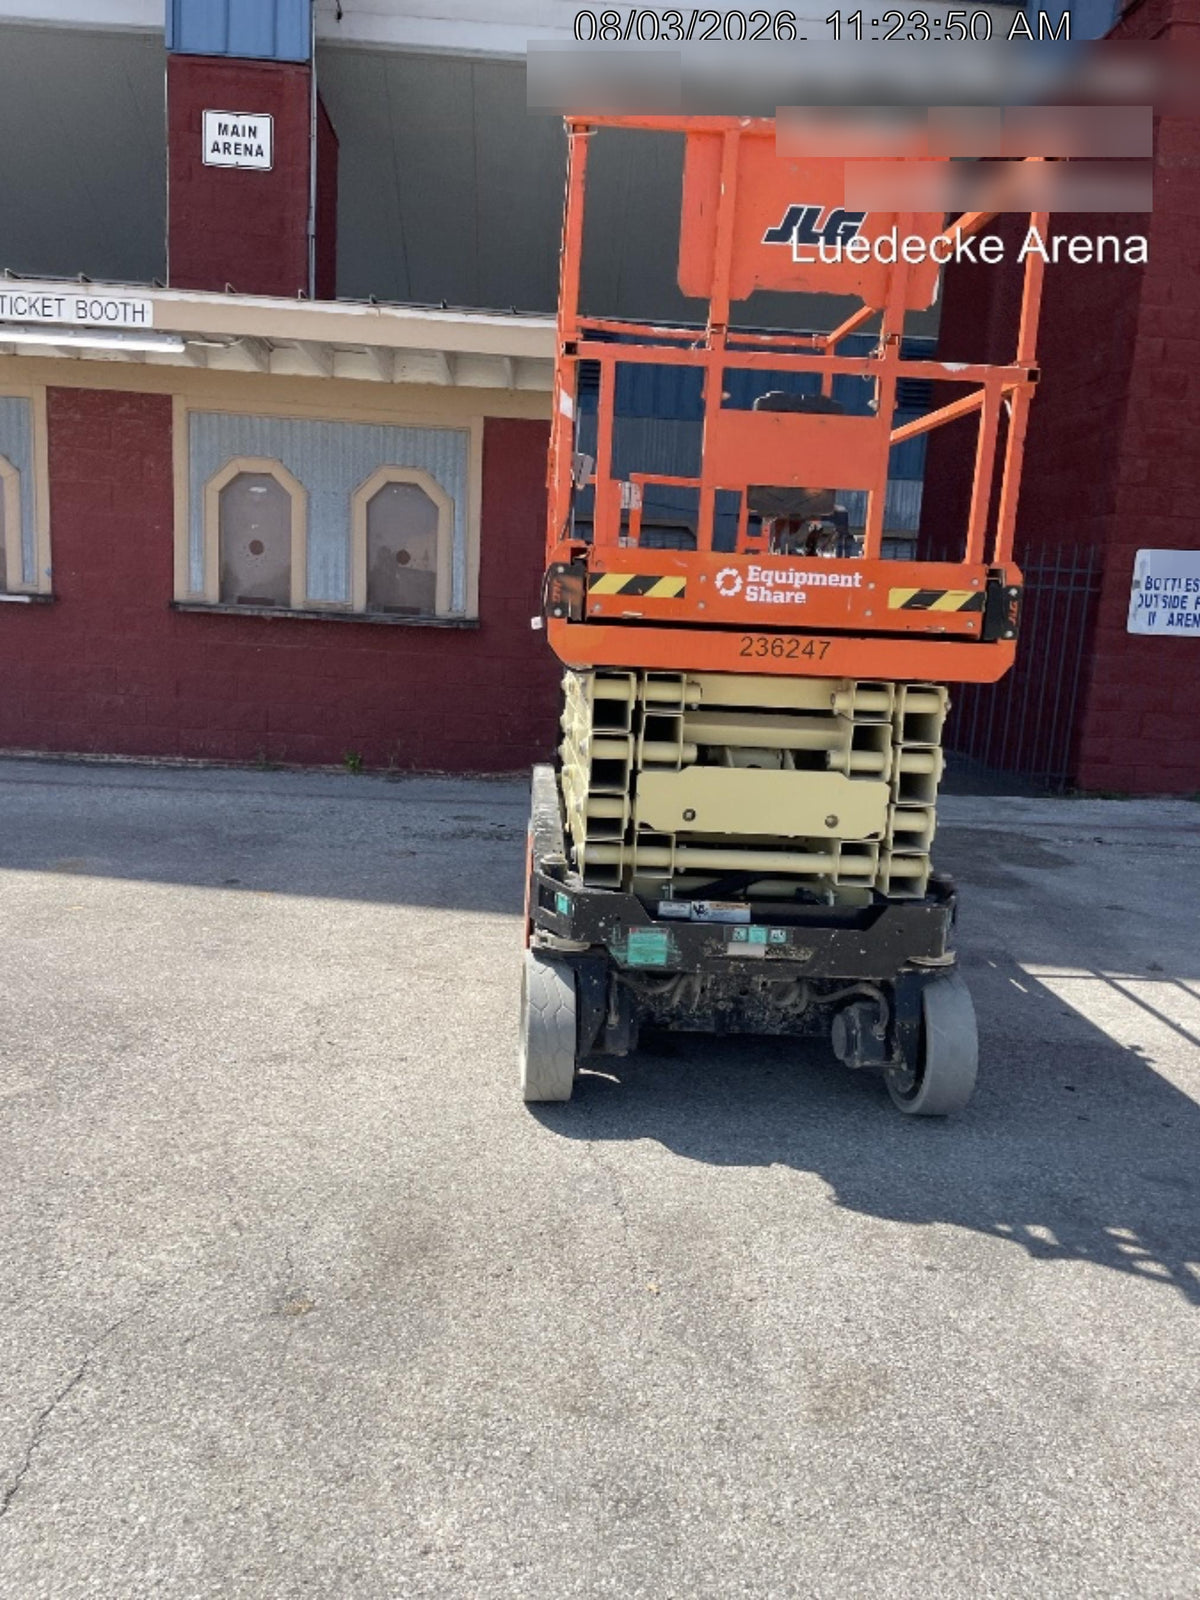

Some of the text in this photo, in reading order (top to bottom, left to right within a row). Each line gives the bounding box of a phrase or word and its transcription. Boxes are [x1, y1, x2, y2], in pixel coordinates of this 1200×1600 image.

[217, 122, 257, 139] MAIN
[211, 141, 264, 157] ARENA
[761, 204, 868, 249] JLG
[0, 295, 145, 322] TICKET BOOTH
[747, 565, 863, 588] Equipment
[745, 586, 806, 604] Share
[740, 636, 831, 660] 236247
